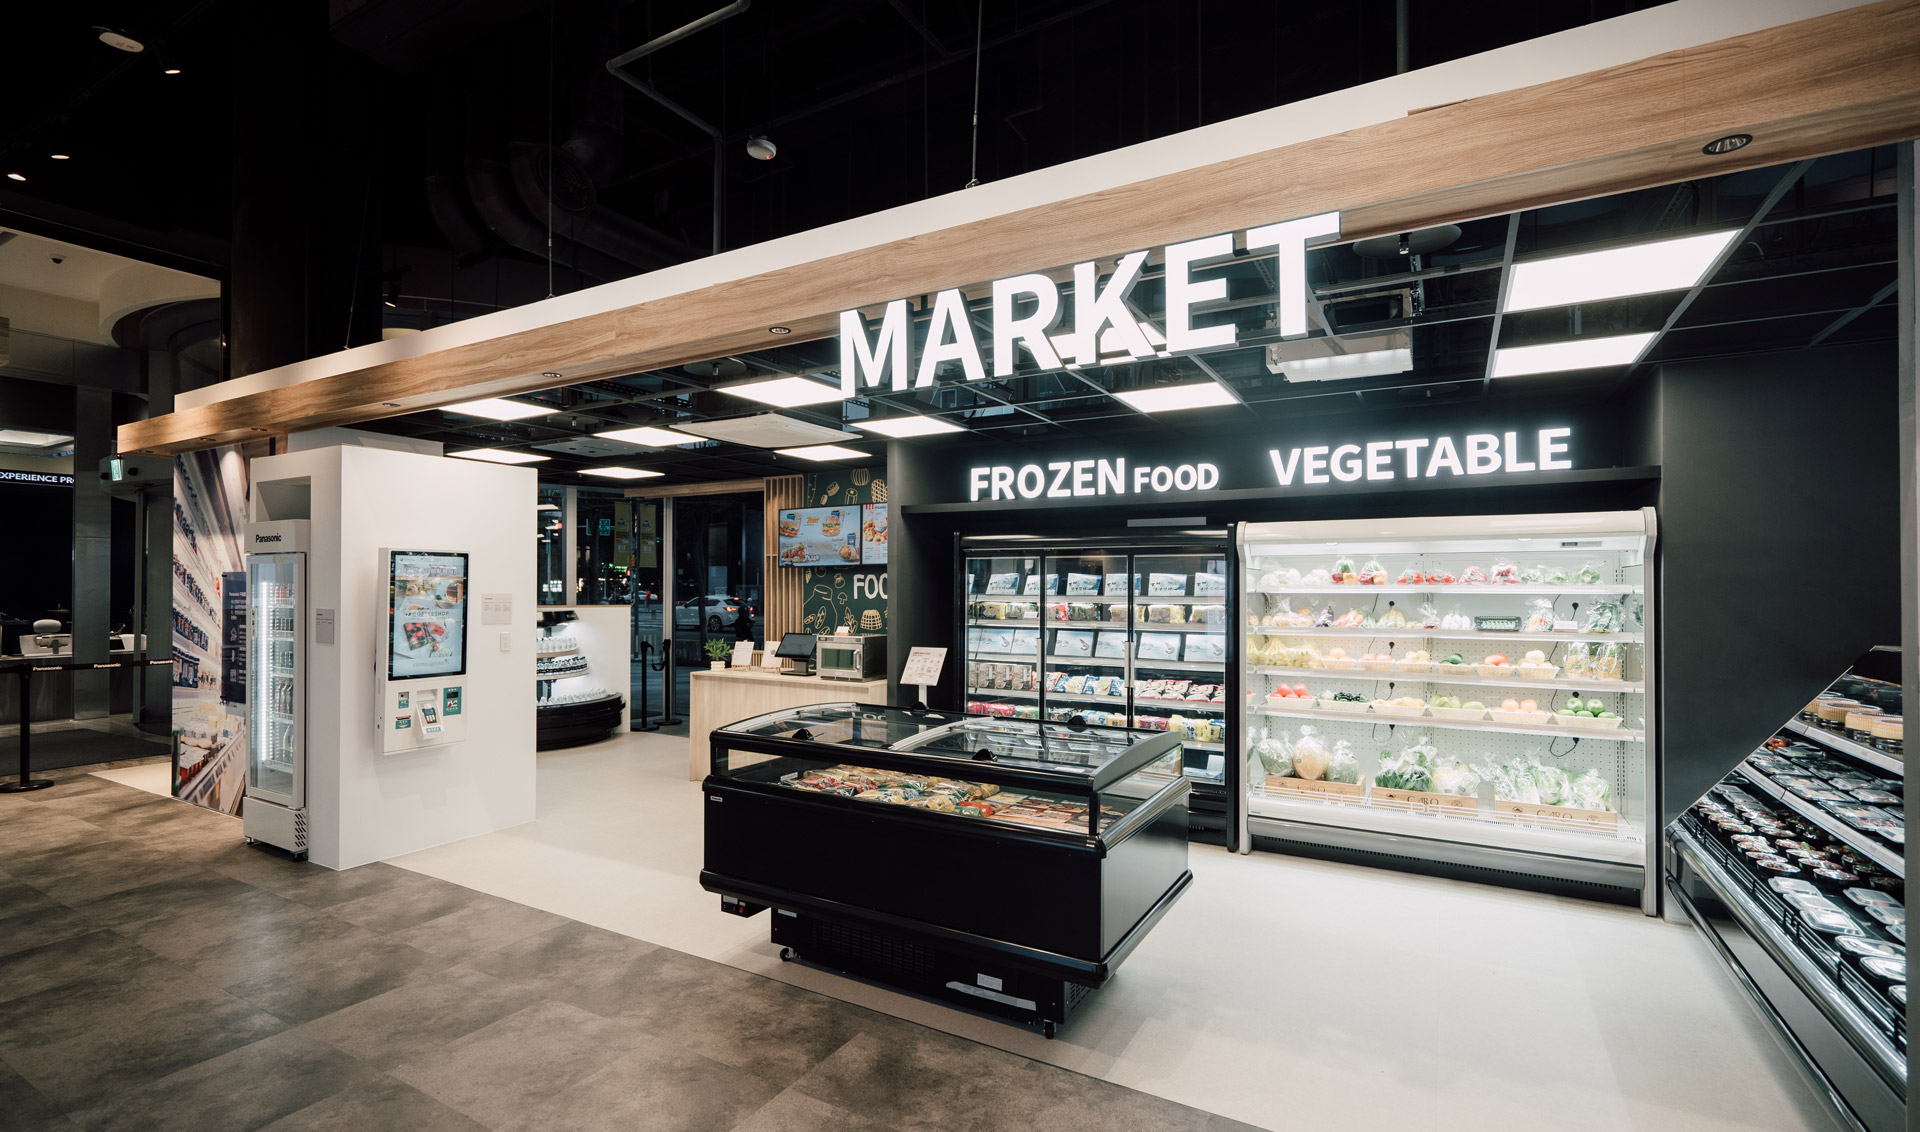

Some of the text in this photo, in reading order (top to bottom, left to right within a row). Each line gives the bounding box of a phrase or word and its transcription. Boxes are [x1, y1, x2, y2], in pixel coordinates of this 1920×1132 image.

[839, 211, 1341, 398] MARKET
[1269, 427, 1573, 486] VEGETABLE
[60, 476, 74, 484] PR
[970, 458, 1220, 501] FROZEN FOOD
[255, 532, 282, 544] Panasonic
